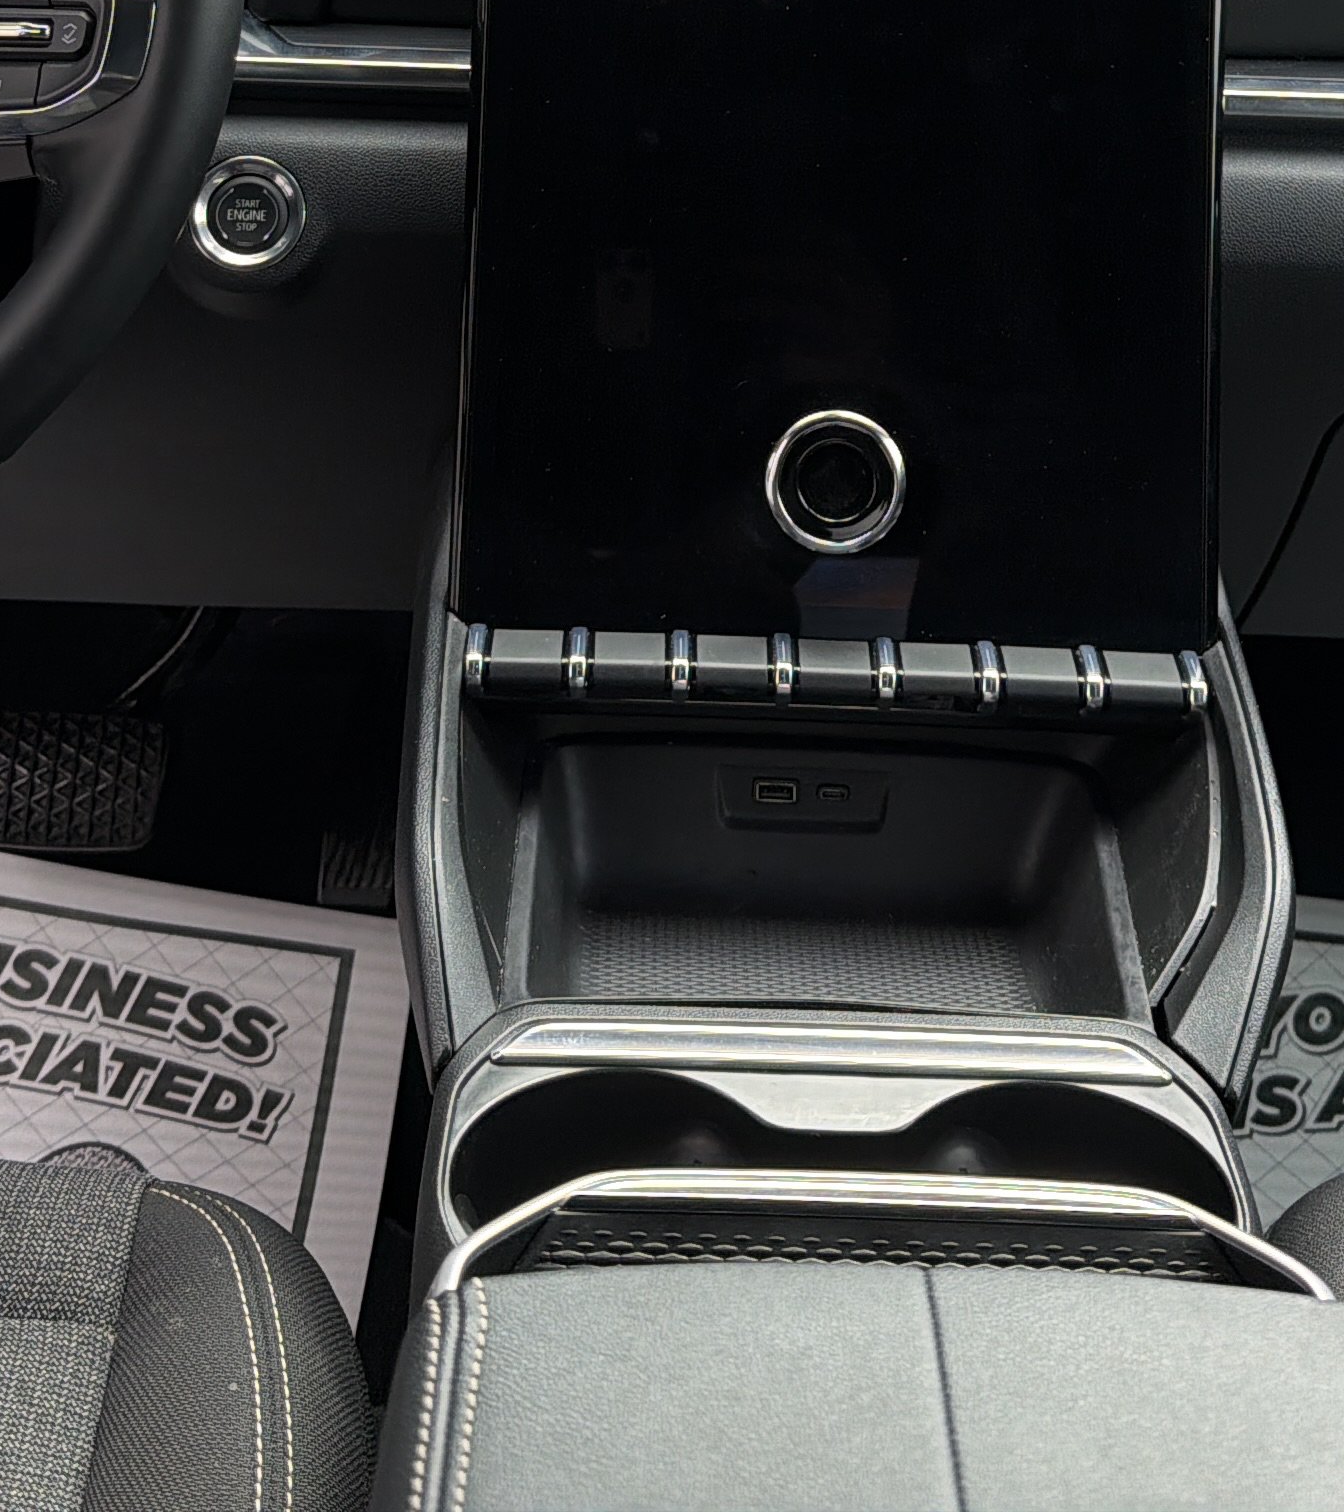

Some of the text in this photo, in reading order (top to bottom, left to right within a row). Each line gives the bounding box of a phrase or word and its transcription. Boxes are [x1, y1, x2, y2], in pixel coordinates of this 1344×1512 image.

[236, 199, 260, 209] START
[227, 209, 267, 222] ENGINE
[236, 222, 257, 232] STOP
